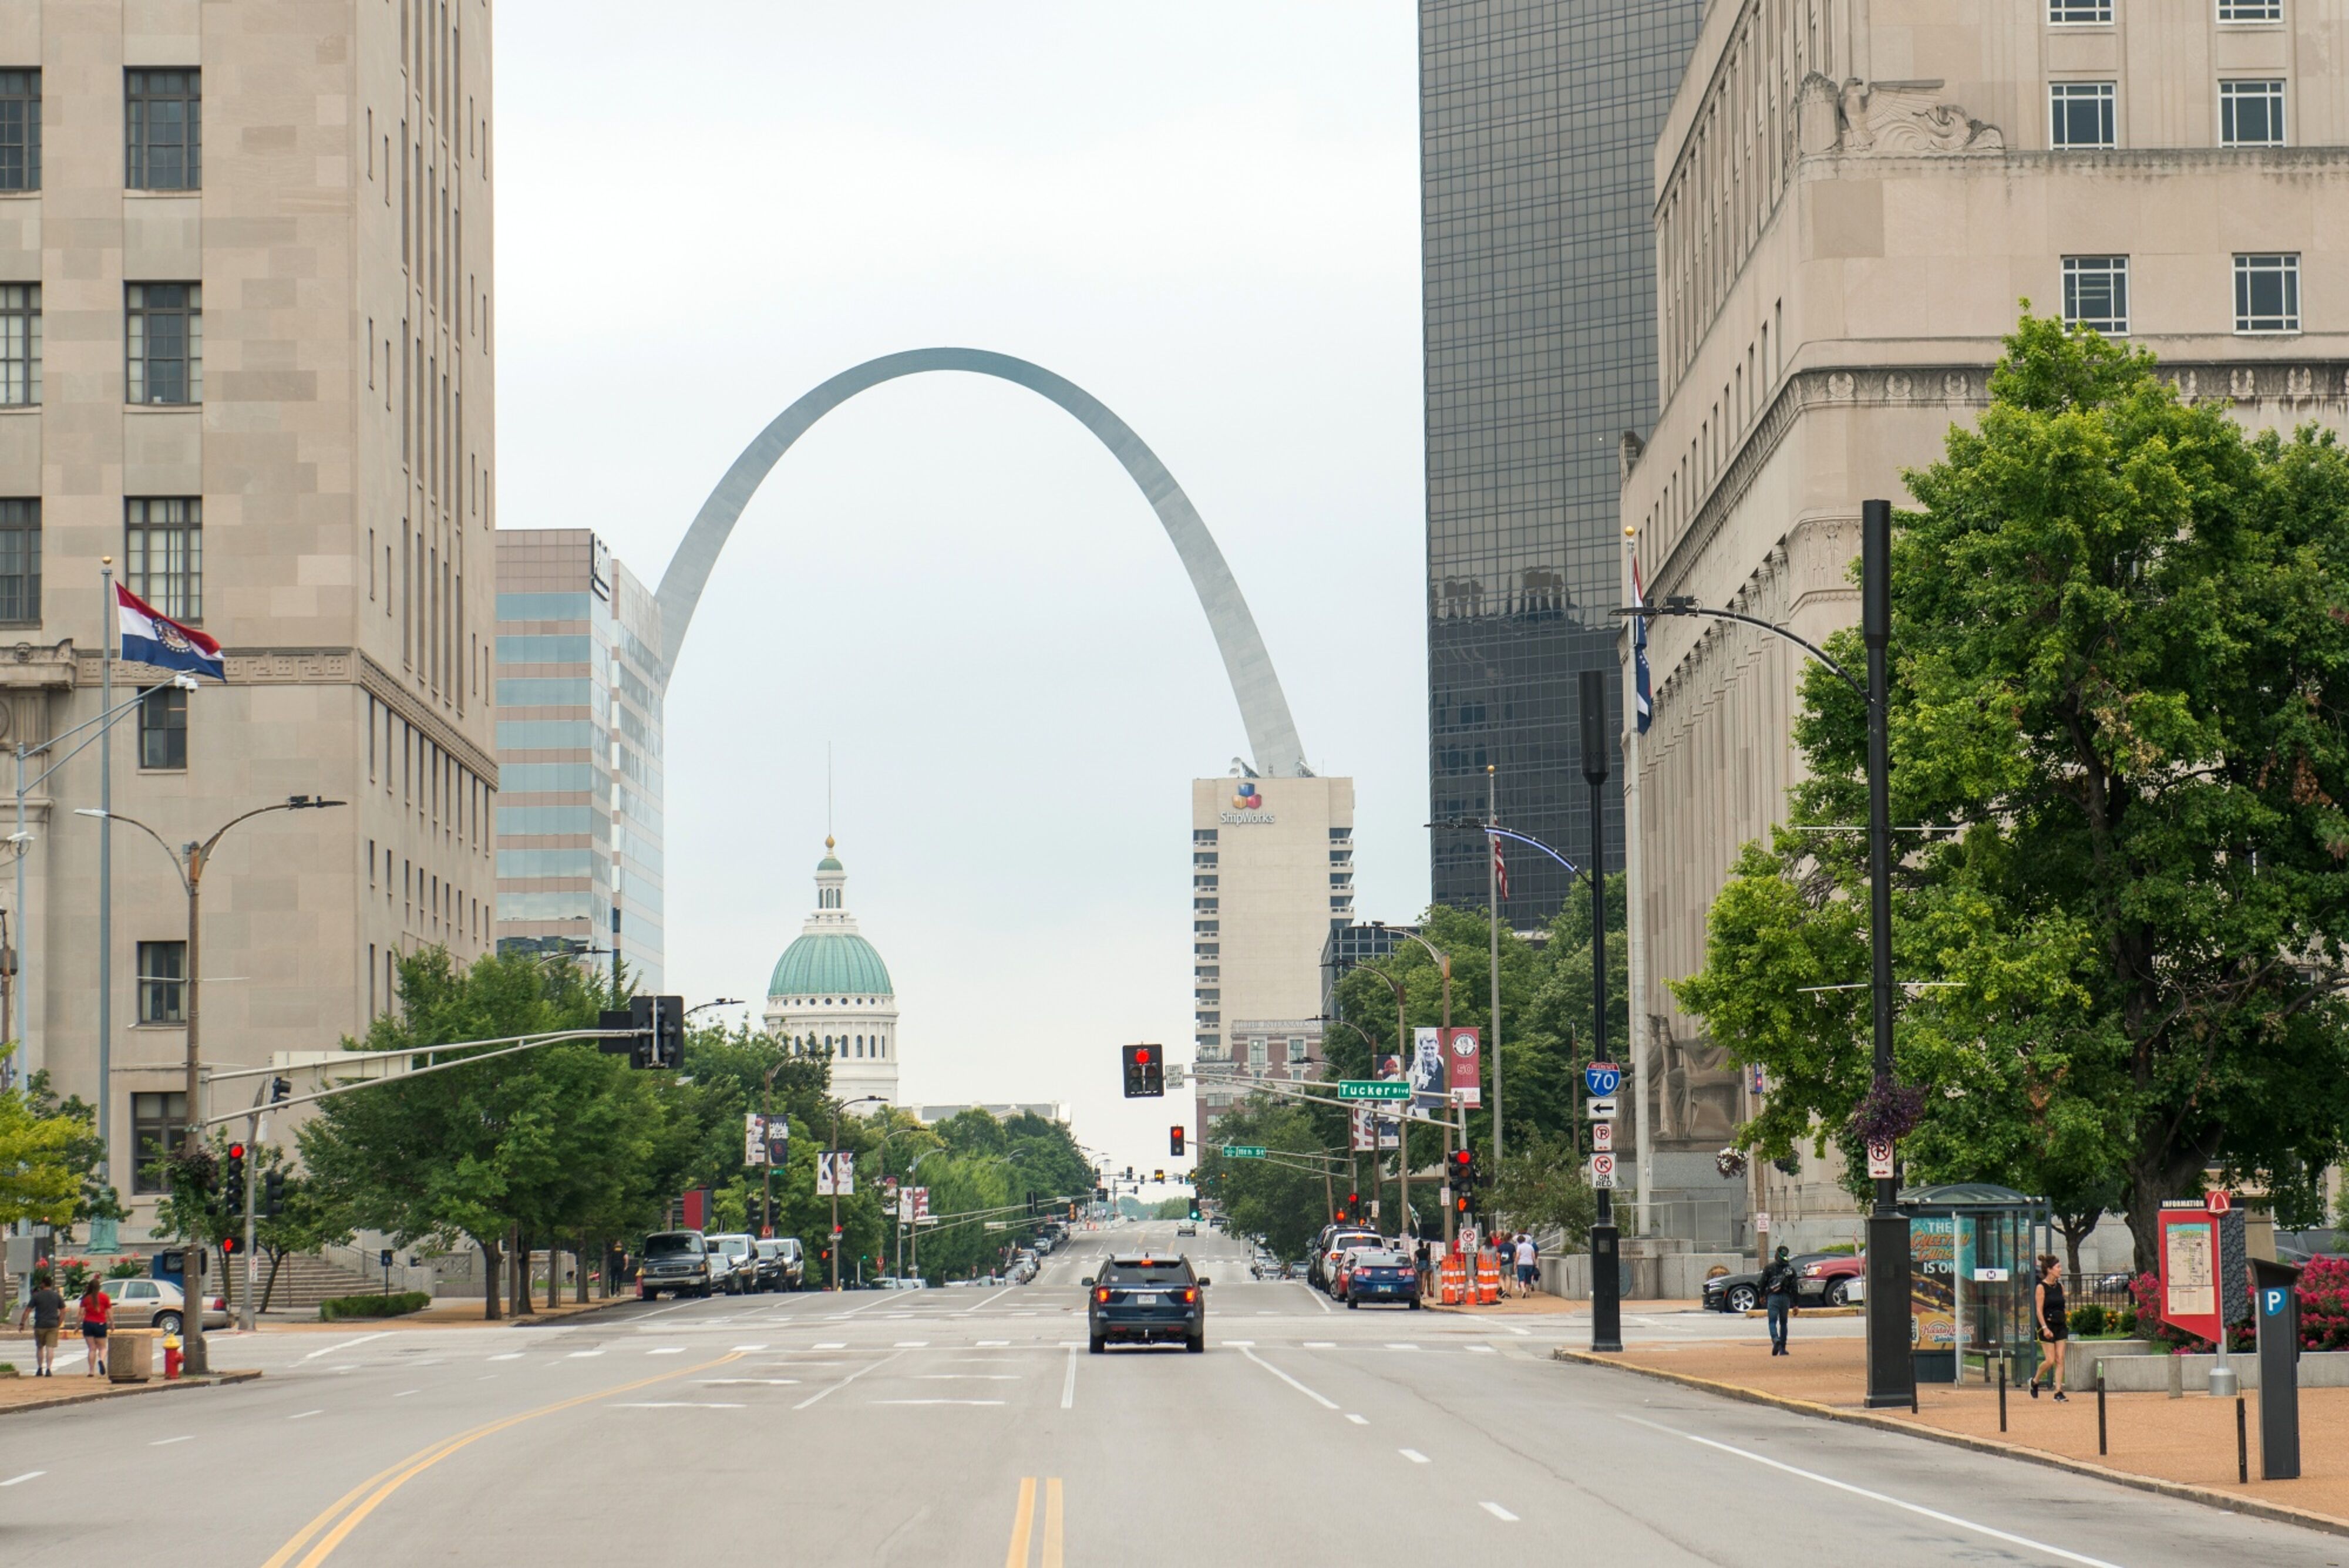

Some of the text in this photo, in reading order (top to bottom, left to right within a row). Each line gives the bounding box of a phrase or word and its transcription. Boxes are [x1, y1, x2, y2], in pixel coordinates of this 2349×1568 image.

[1220, 812, 1274, 826] ShipWorks
[1457, 1064, 1473, 1075] 50
[1591, 1073, 1614, 1089] 70
[1341, 1084, 1390, 1096] Tucker
[1928, 1222, 1952, 1233] THE
[1911, 1230, 1971, 1249] CHEETH
[1917, 1246, 1958, 1262] CHAS
[1923, 1262, 1936, 1274] IS
[2268, 1291, 2281, 1311] P
